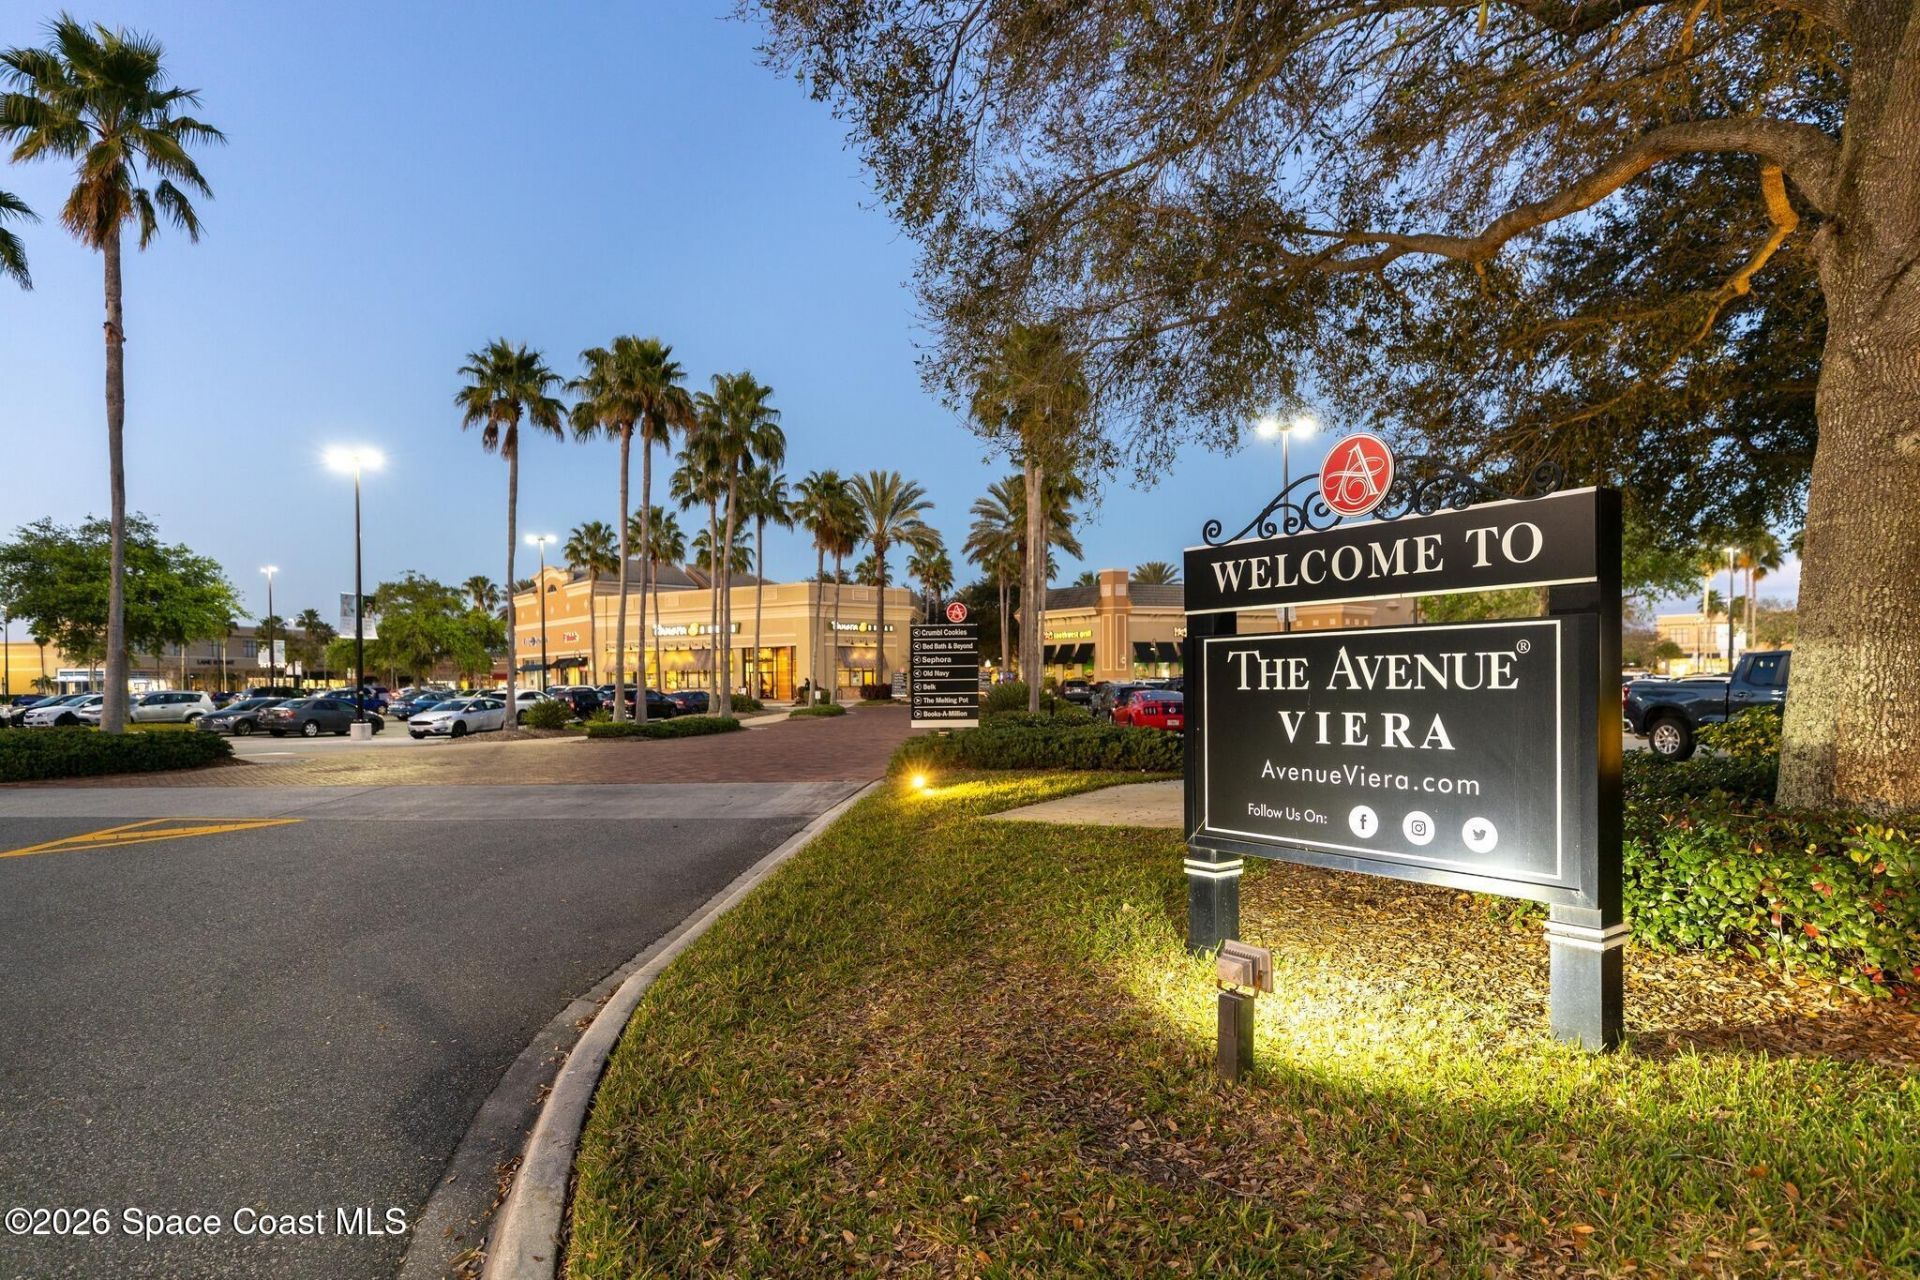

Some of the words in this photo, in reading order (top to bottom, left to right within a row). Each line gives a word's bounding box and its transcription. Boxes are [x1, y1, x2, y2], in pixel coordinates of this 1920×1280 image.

[1211, 533, 1444, 594] WELCOME
[1465, 521, 1544, 569] TO
[953, 642, 973, 651] Beyond
[934, 670, 950, 678] Navy
[1227, 650, 1310, 691] THE
[936, 696, 957, 705] Melting
[958, 696, 969, 704] Pot
[1278, 711, 1456, 751] VIERA
[1261, 759, 1481, 796] AvenueViera.com
[1247, 802, 1283, 820] Follow
[1285, 806, 1301, 822] Us
[1303, 808, 1328, 825] On:
